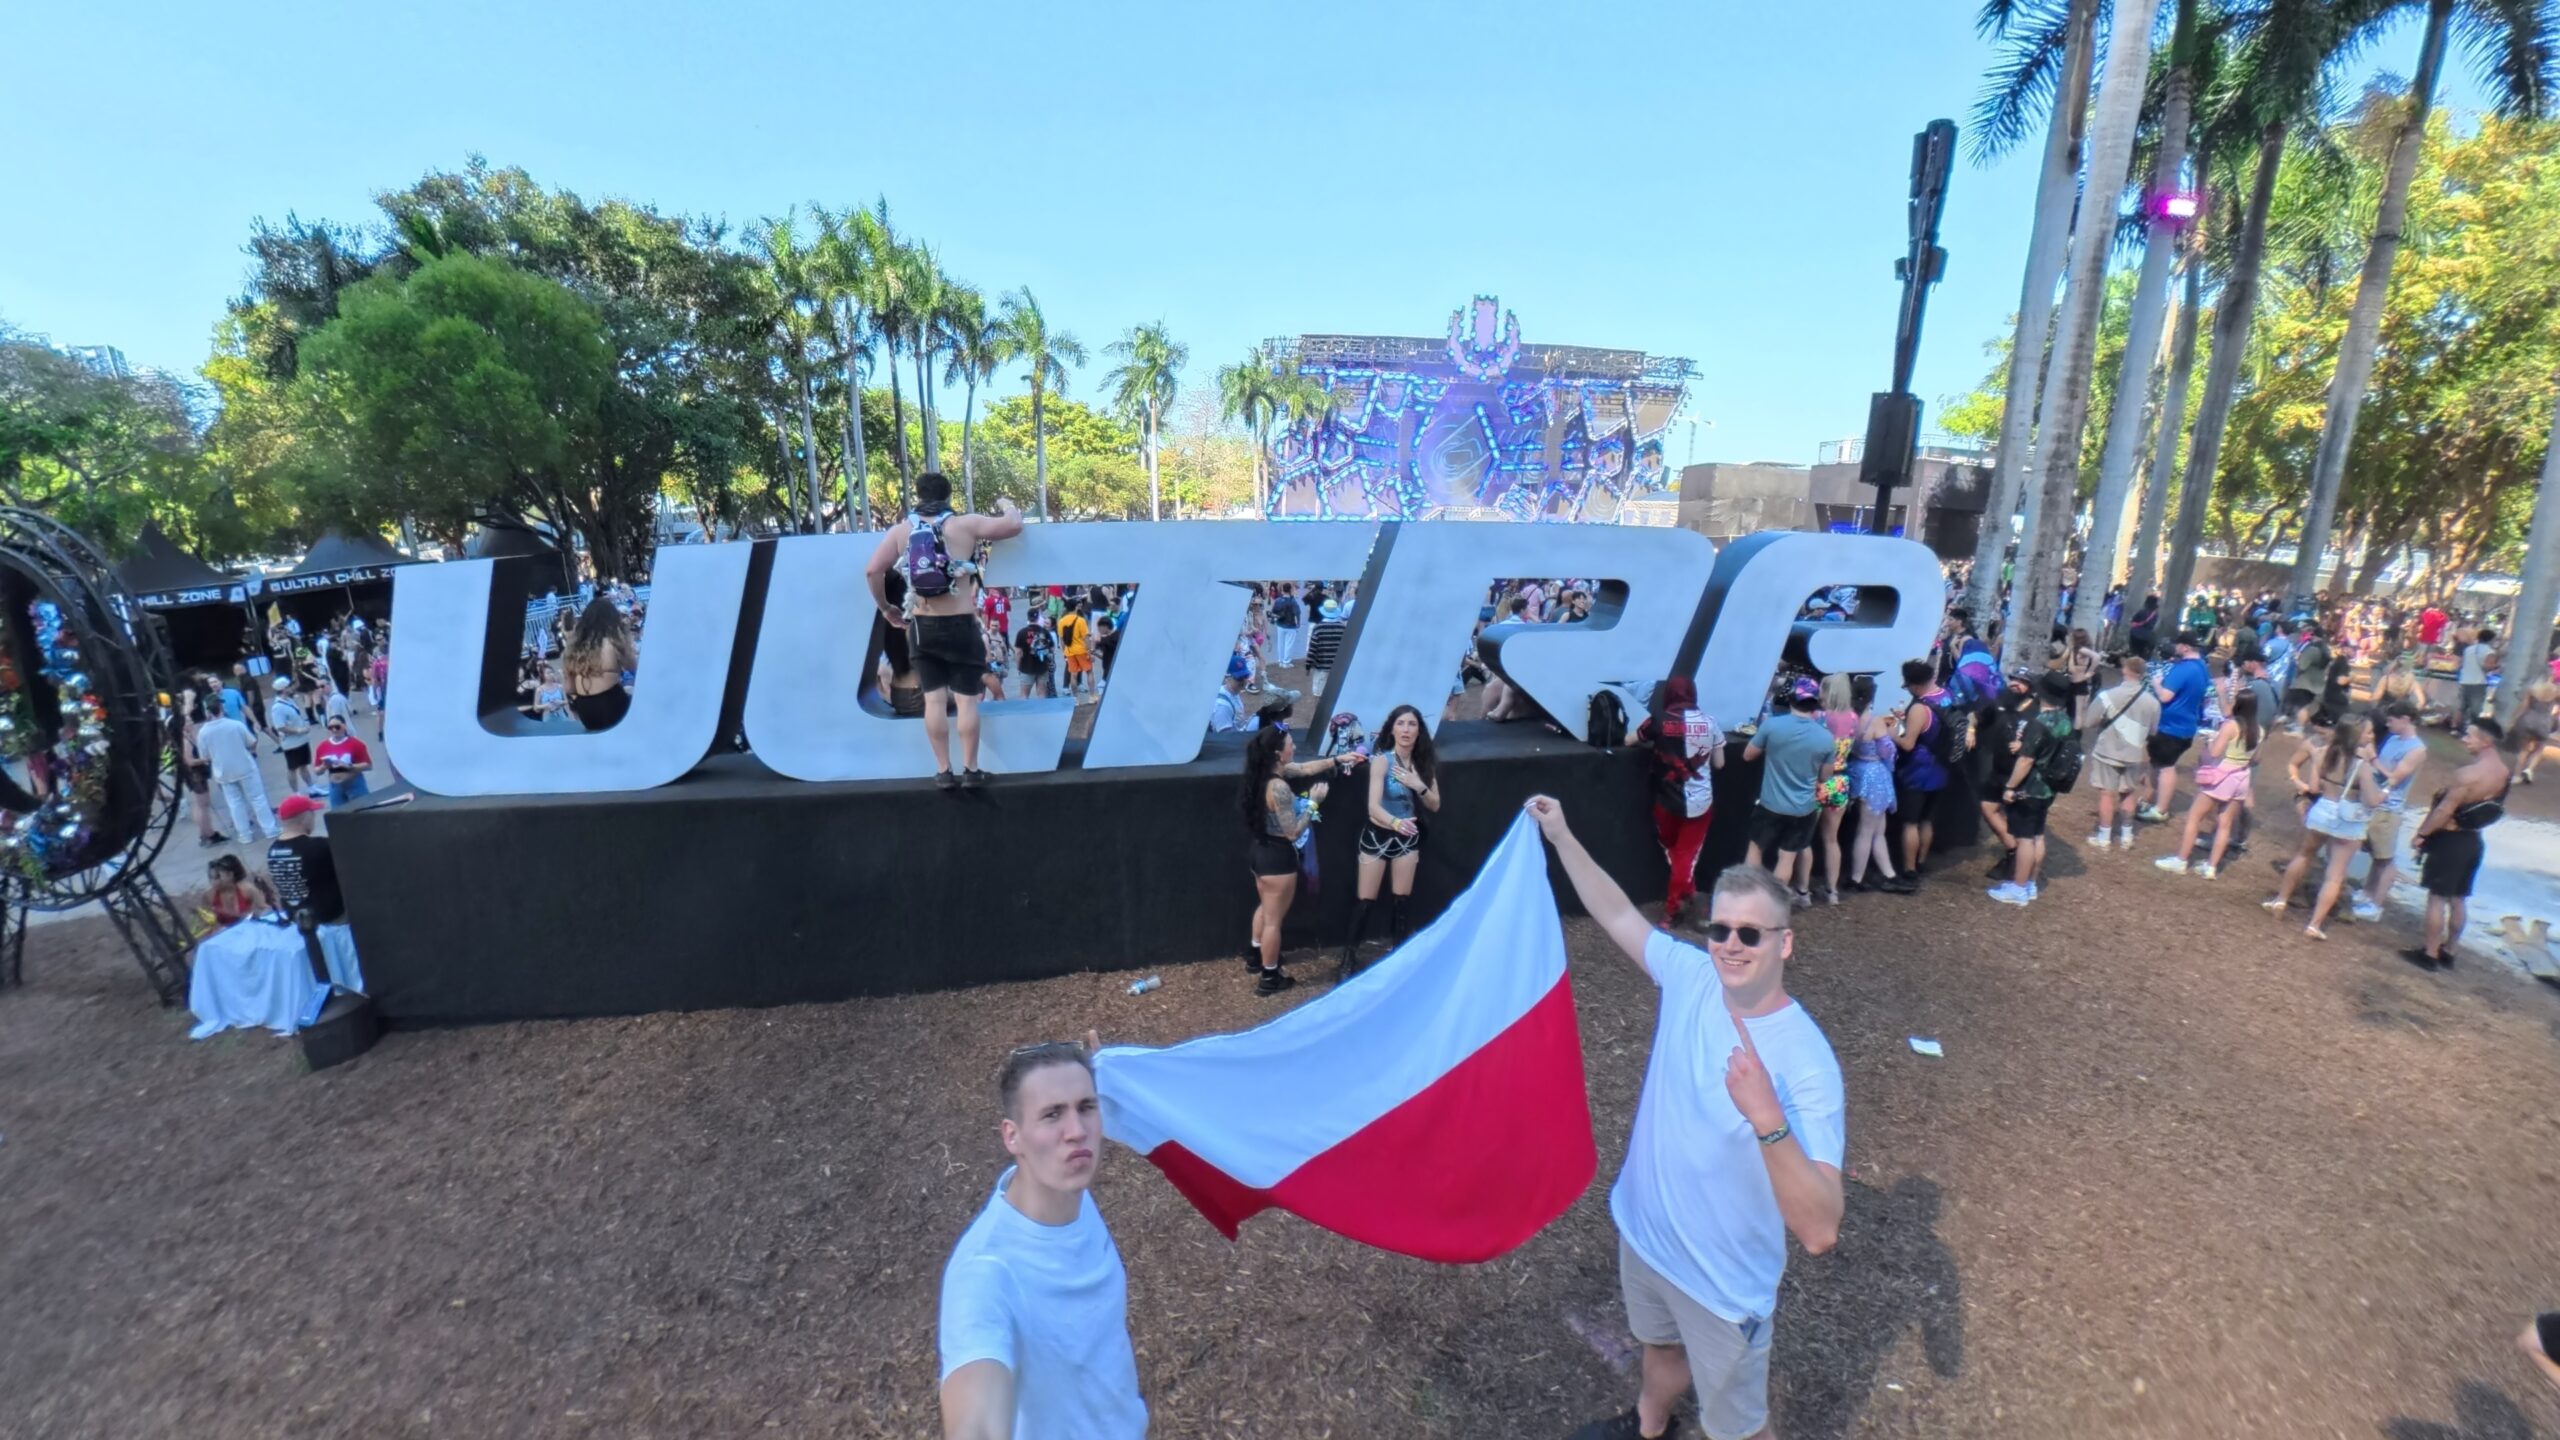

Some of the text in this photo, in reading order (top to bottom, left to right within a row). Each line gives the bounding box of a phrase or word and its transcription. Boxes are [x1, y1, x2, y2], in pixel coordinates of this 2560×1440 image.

[279, 576, 331, 591] ULTRA
[335, 570, 376, 584] CHILL
[138, 589, 221, 607] HILL ZONE
[384, 520, 1946, 797] ULTRA
